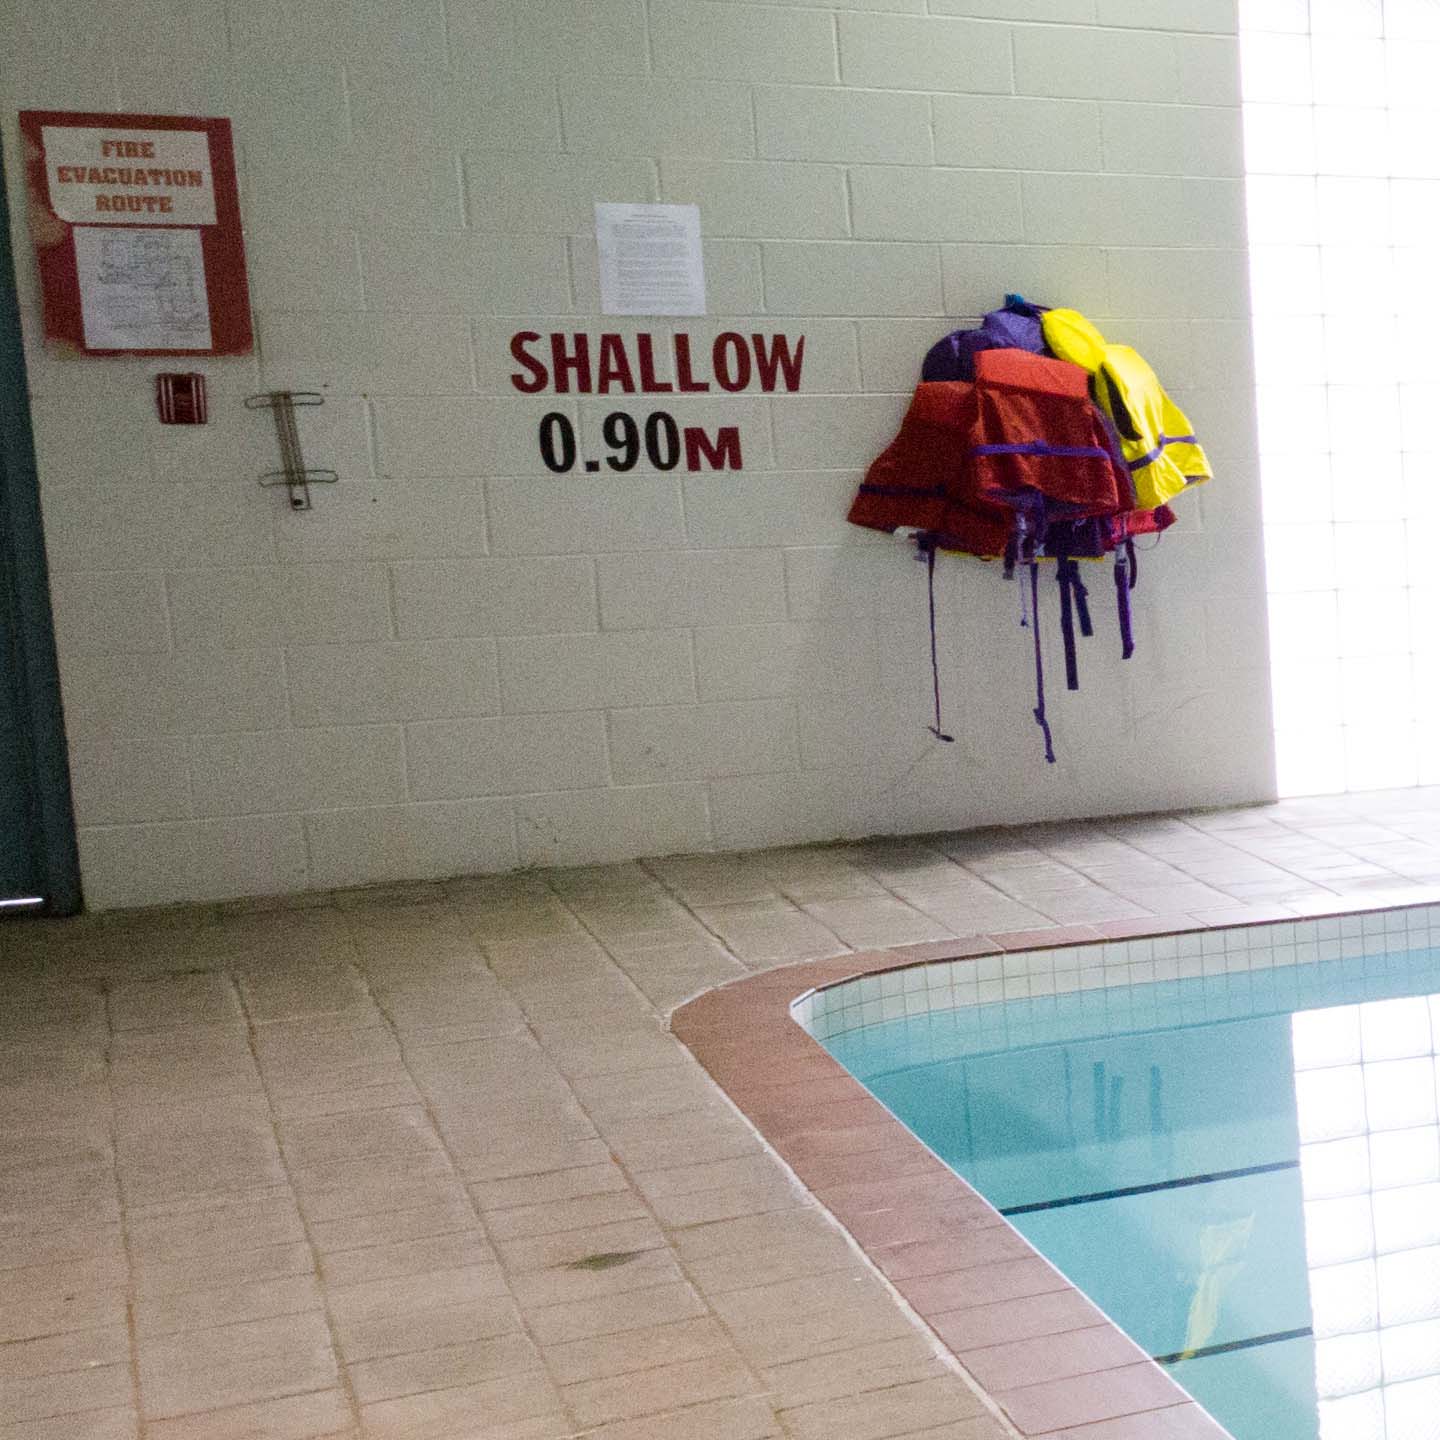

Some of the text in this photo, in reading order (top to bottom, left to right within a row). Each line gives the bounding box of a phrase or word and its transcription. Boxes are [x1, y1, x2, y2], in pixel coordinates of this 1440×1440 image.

[101, 138, 155, 159] FIRE
[57, 165, 203, 188] EVACUATION
[95, 194, 174, 214] ROUTE
[509, 331, 806, 395] SHALLOW
